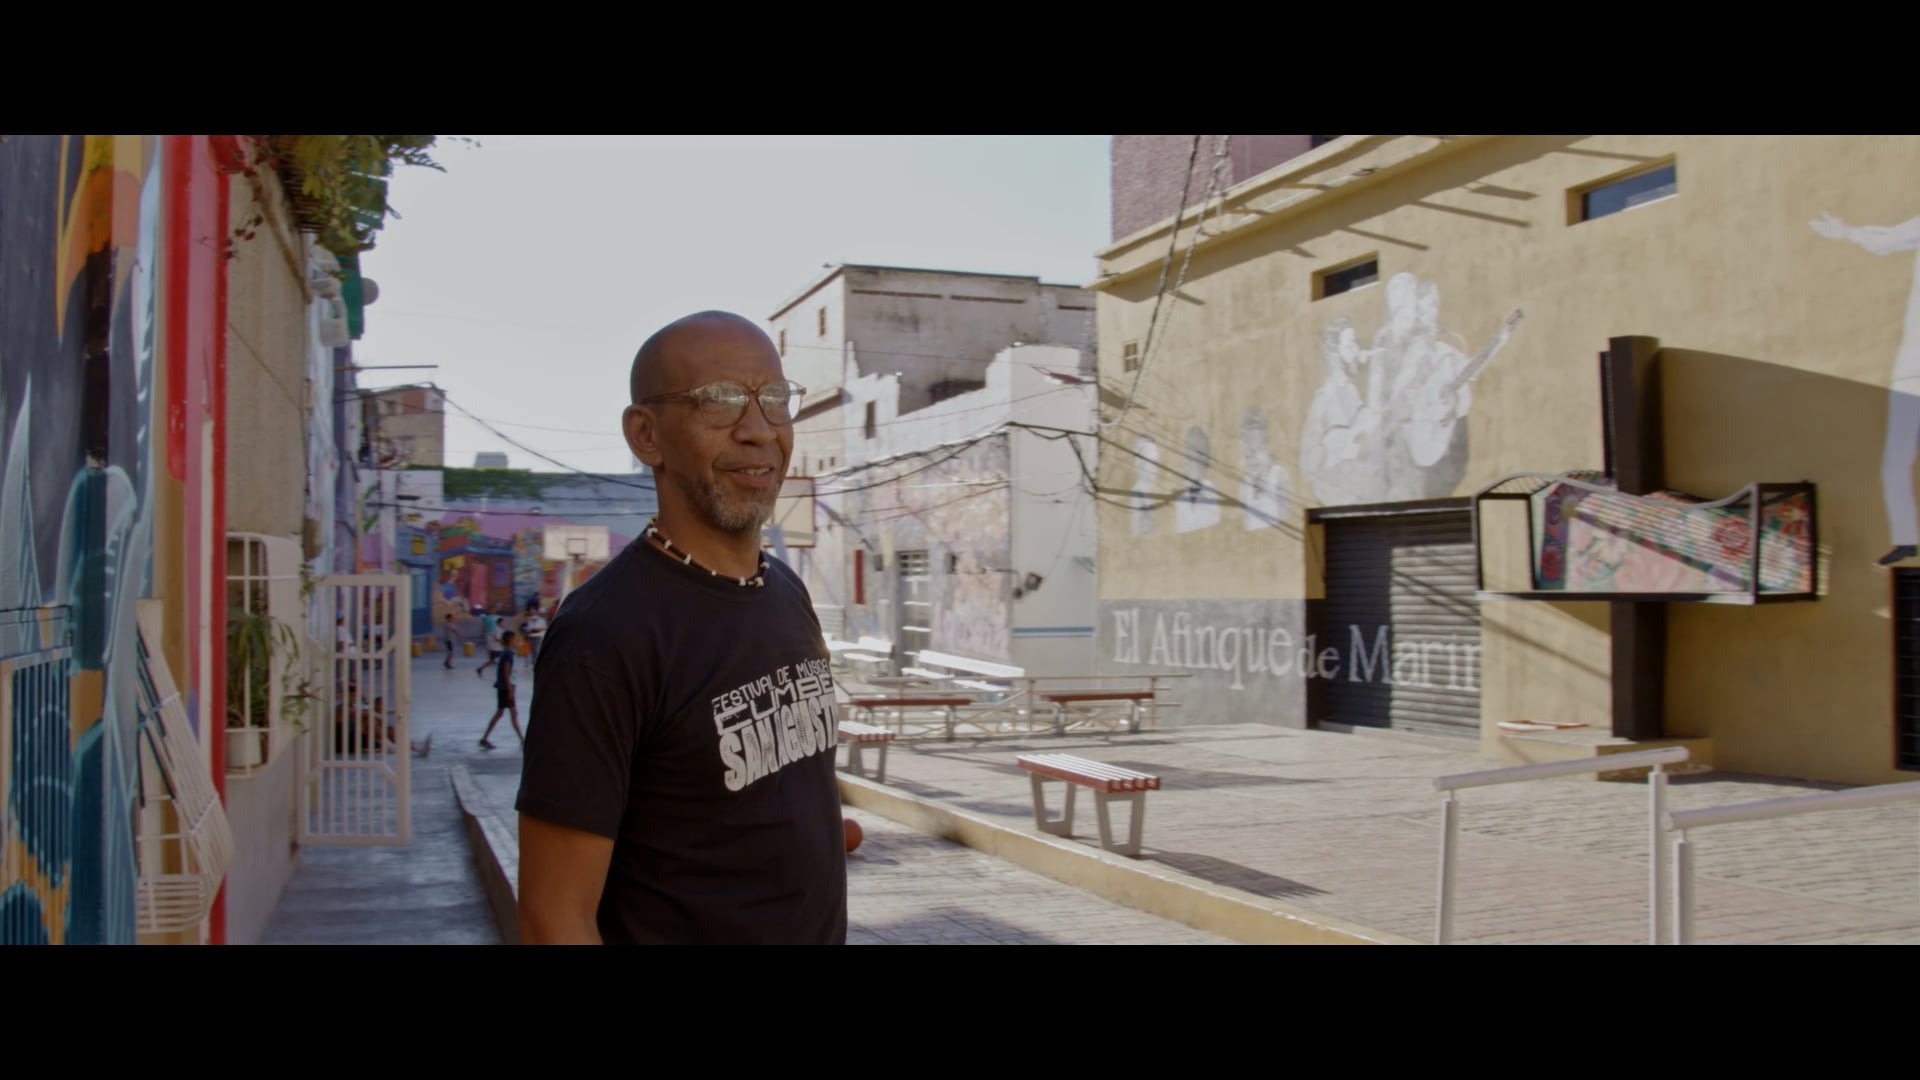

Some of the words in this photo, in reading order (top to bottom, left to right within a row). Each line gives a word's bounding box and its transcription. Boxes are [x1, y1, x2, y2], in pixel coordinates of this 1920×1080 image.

[1112, 607, 1140, 664] El
[1147, 611, 1293, 690] Afinque
[1297, 634, 1341, 680] de
[712, 674, 775, 716] FESTIVAL
[777, 665, 792, 685] DE
[714, 673, 835, 736] CUMBE
[719, 715, 780, 792] SAN
